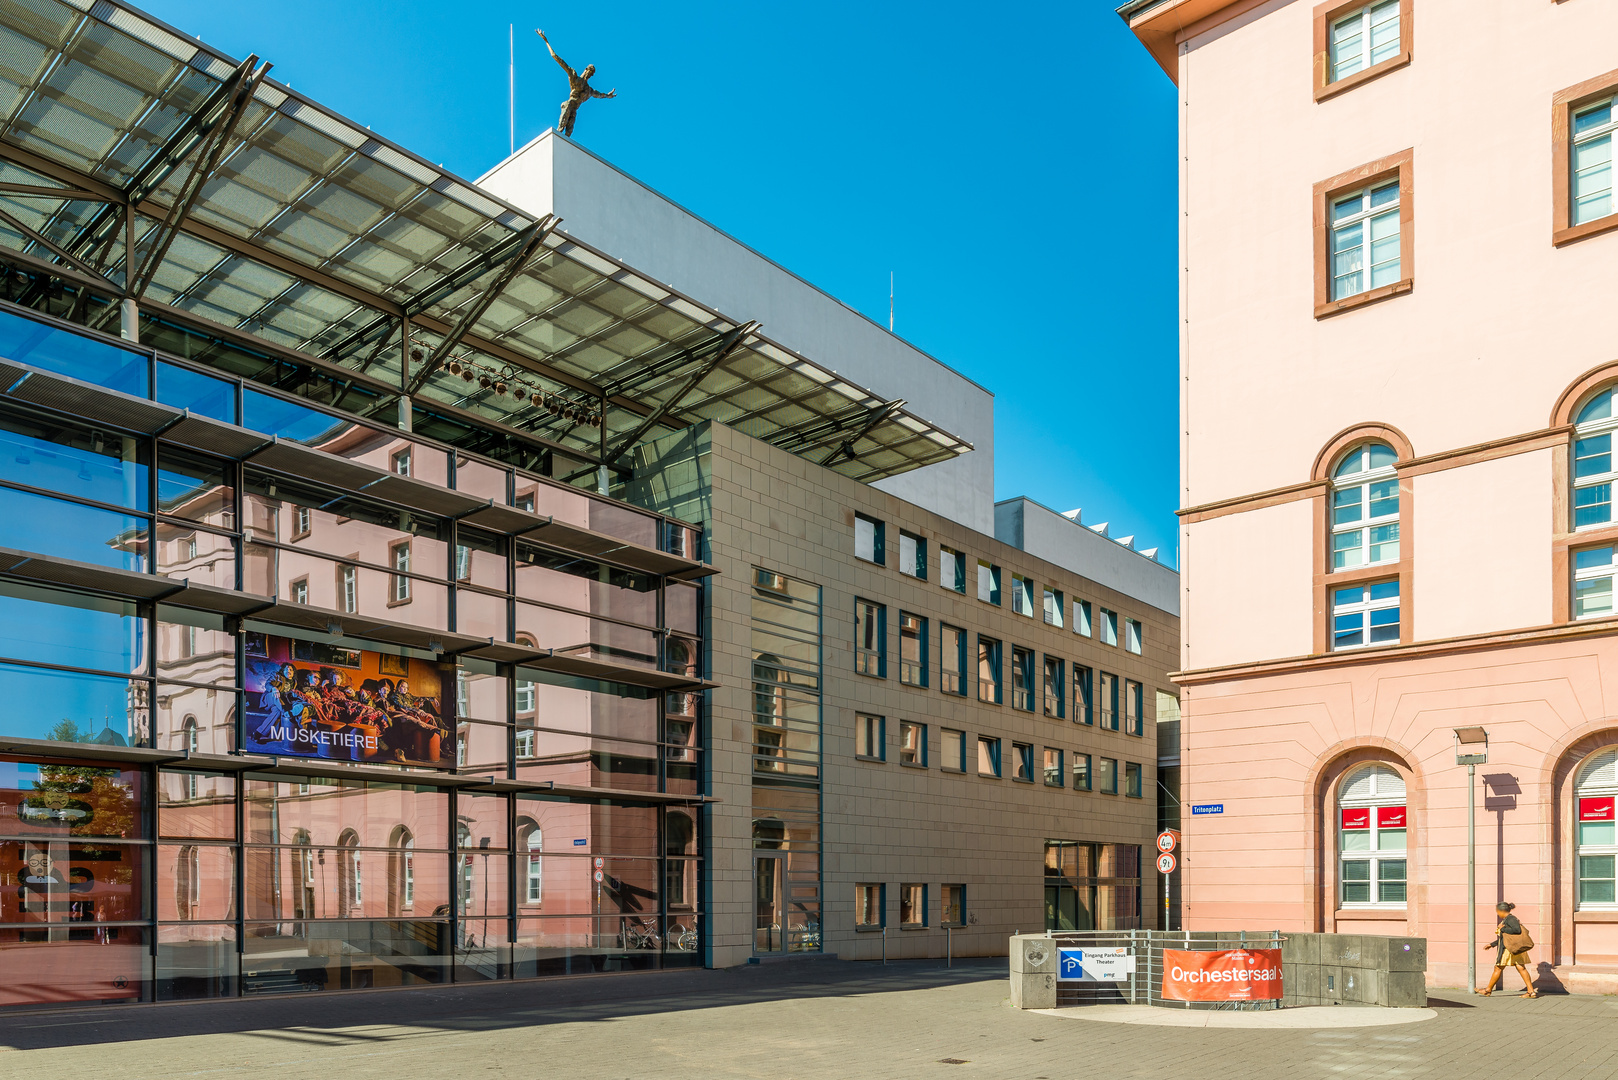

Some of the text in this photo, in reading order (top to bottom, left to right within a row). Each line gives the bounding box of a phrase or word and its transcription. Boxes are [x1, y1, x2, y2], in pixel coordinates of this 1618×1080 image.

[270, 725, 379, 750] MUSKETIERE!
[1067, 961, 1076, 973] P
[1171, 966, 1277, 983] Orchestersaal
